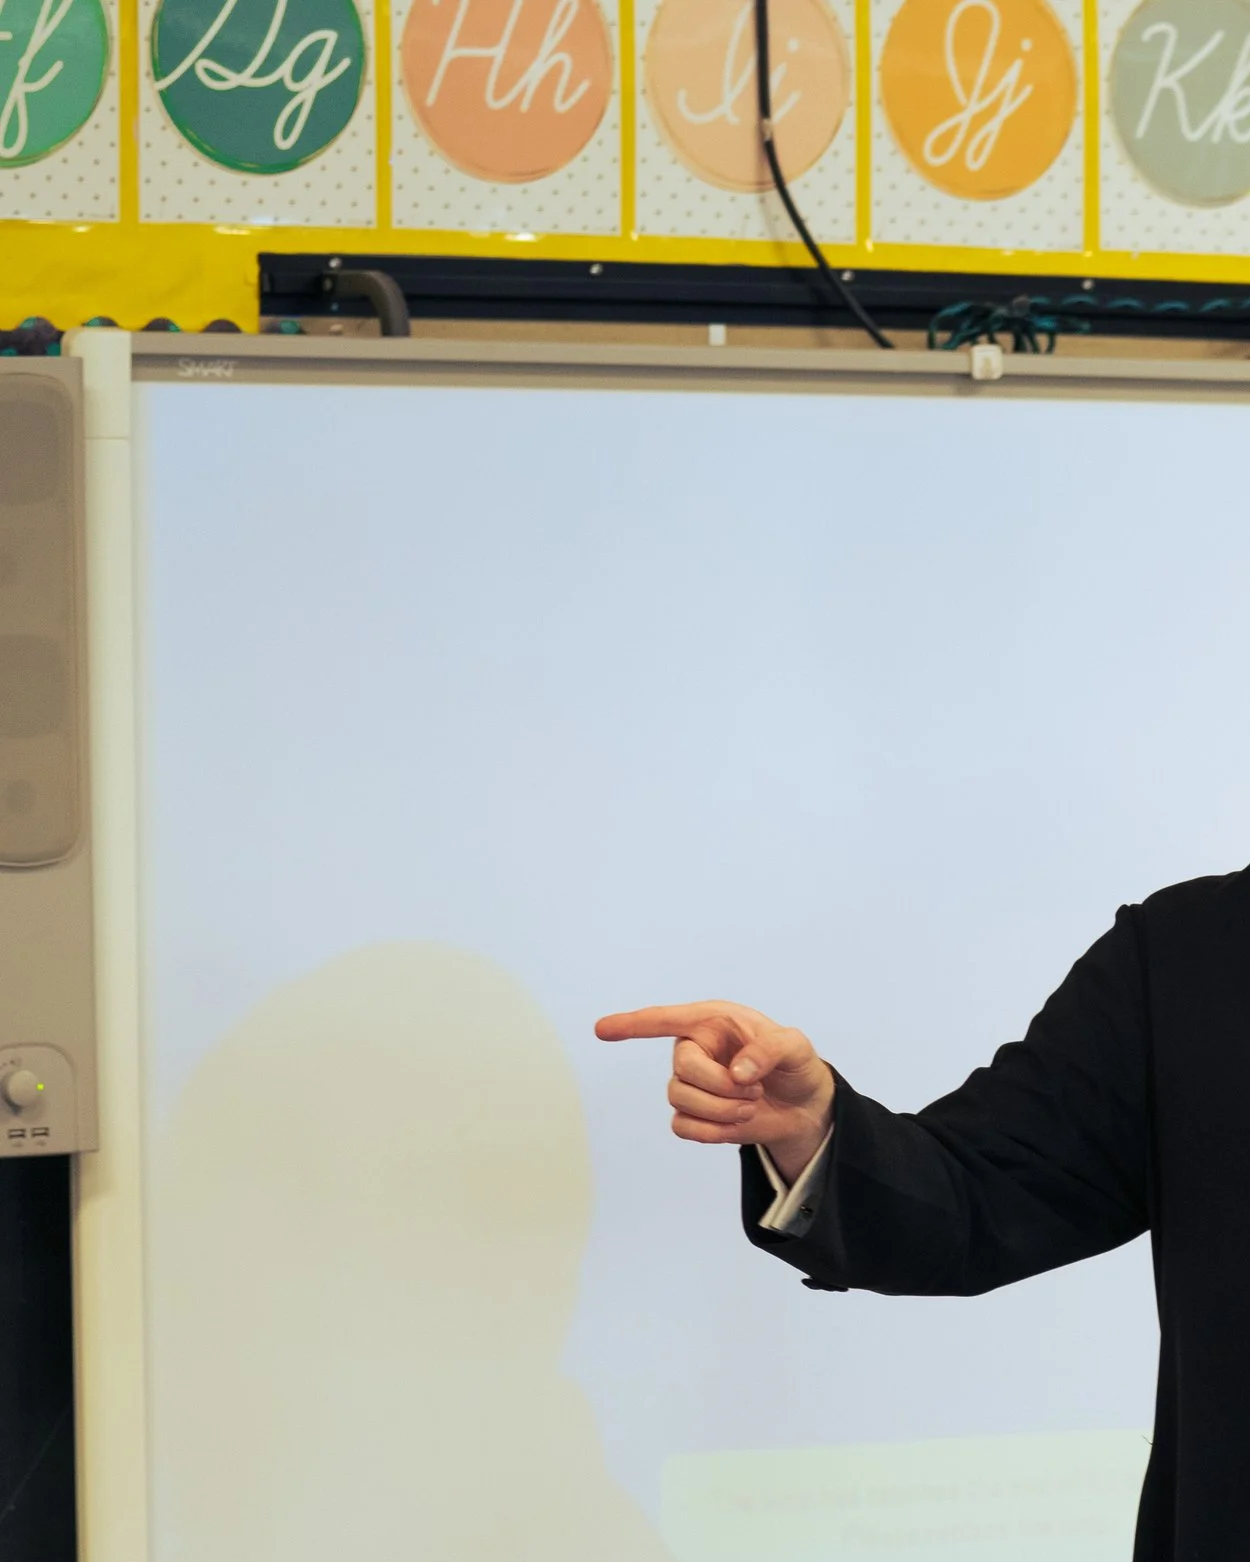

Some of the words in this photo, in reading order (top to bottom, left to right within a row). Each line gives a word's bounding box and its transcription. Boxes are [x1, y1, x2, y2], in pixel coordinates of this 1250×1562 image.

[0, 0, 64, 159] f
[425, 0, 592, 113] Hh
[922, 0, 1033, 171] Jj
